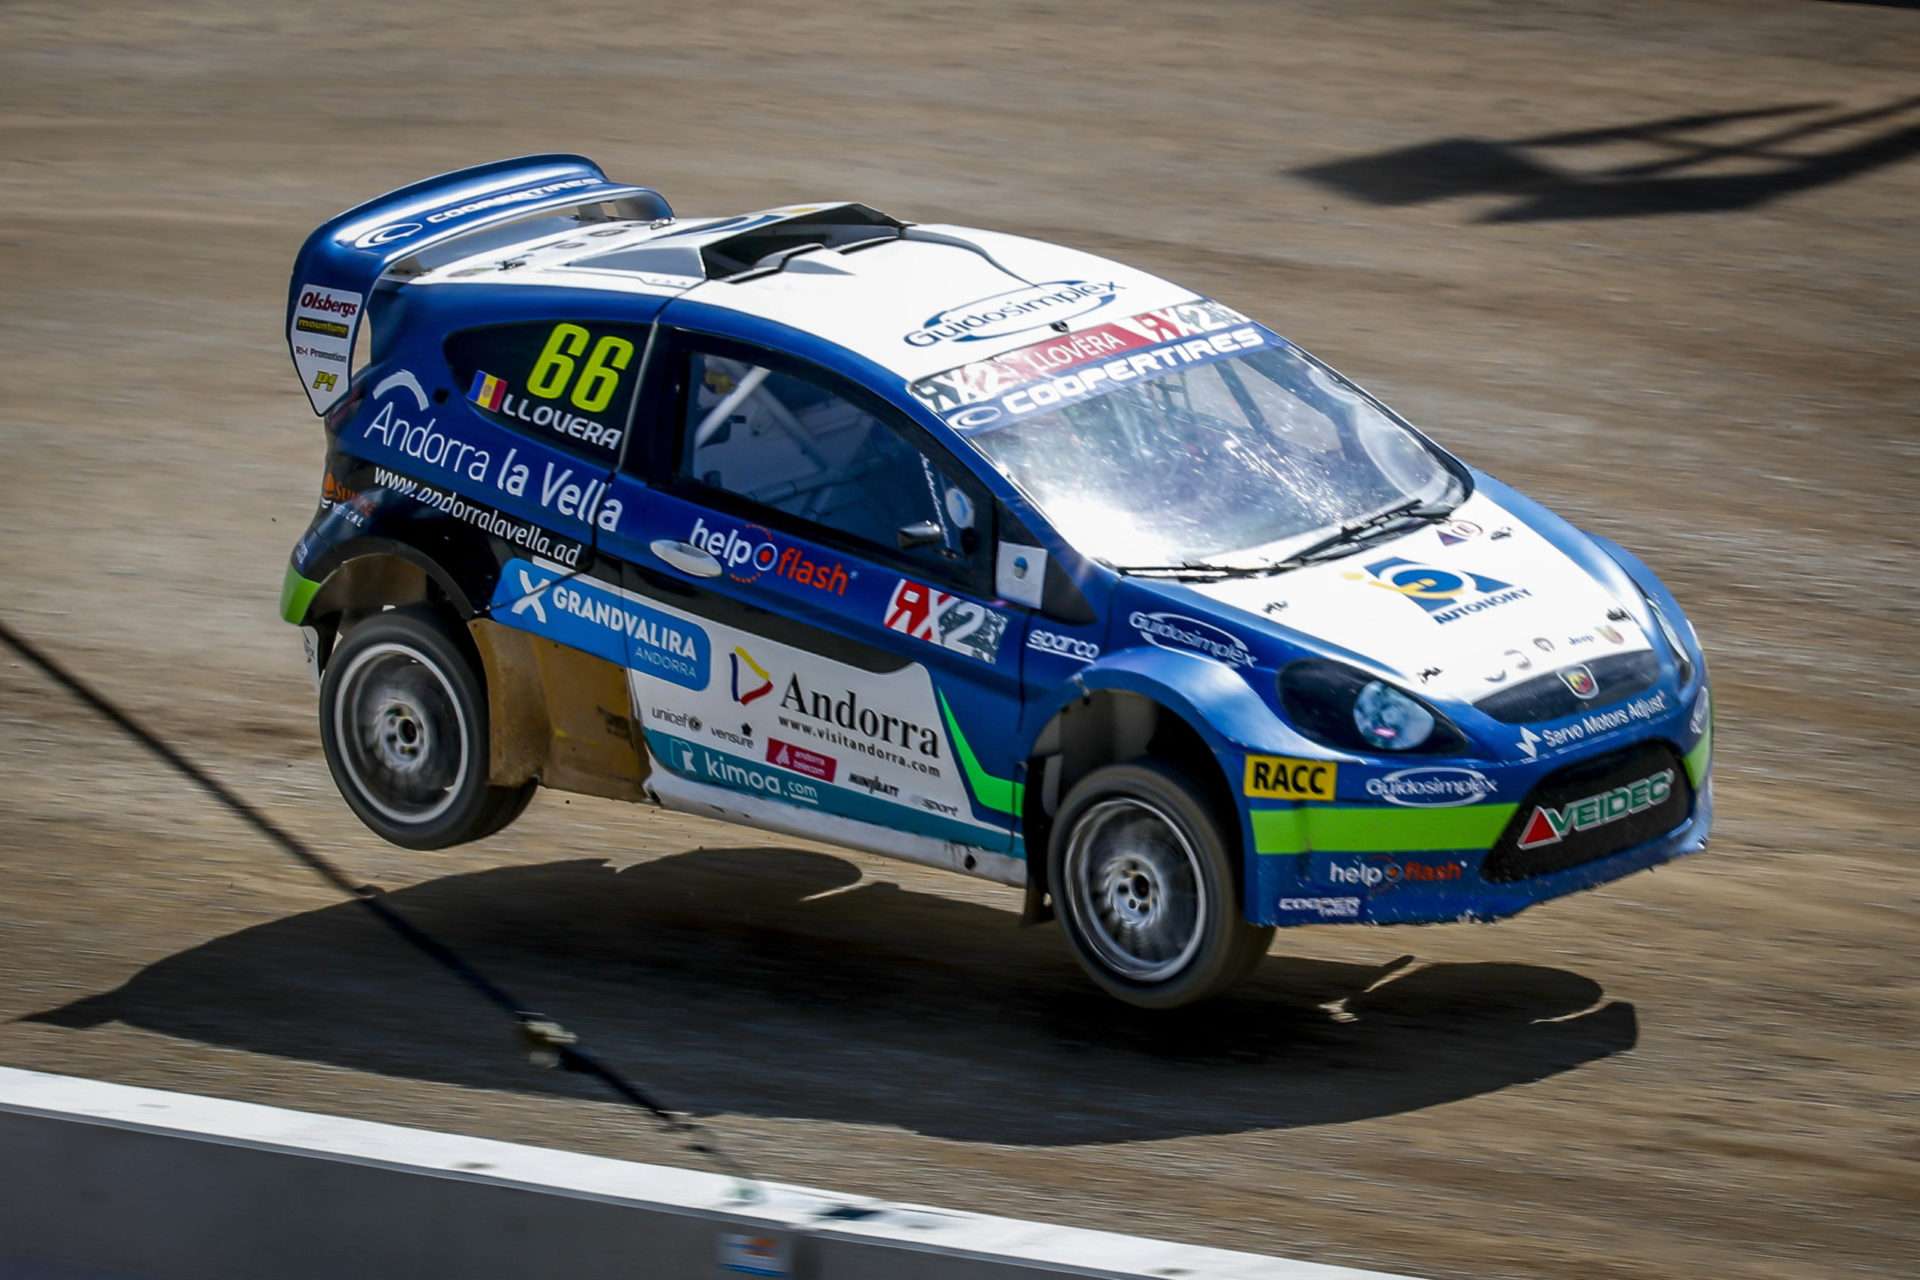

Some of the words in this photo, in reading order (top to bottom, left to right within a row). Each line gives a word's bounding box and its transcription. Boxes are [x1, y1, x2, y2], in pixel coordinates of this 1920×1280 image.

[301, 292, 358, 317] Olsbergs
[903, 281, 1127, 347] Guidosimplex
[527, 322, 634, 412] 66
[1002, 327, 1264, 414] COOPERTIRES
[502, 394, 623, 450] LLOVERA
[363, 401, 490, 482] Andorra
[497, 448, 529, 497] la
[541, 461, 623, 533] Vella
[374, 467, 582, 566] www.andorralavella.ad
[776, 547, 849, 596] flash
[552, 587, 697, 661] GRANDVALIRA
[884, 578, 997, 661] RX2
[1433, 589, 1533, 625] AUTONOMY
[634, 646, 697, 678] ANDORRA
[1027, 629, 1099, 659] sparco
[1129, 611, 1258, 668] Guidosimplex
[652, 707, 689, 728] unicef
[711, 727, 754, 749] verisure
[780, 672, 940, 759] Andorra
[1542, 724, 1585, 748] Servo
[1582, 709, 1629, 735] Motors
[778, 716, 941, 778] www.visitandorra.com
[705, 751, 818, 800] kimoa.com
[1253, 761, 1326, 795] RACC
[1366, 776, 1498, 798] Guidosimplex
[1545, 771, 1672, 836] VEIDEC
[1330, 861, 1382, 887] help
